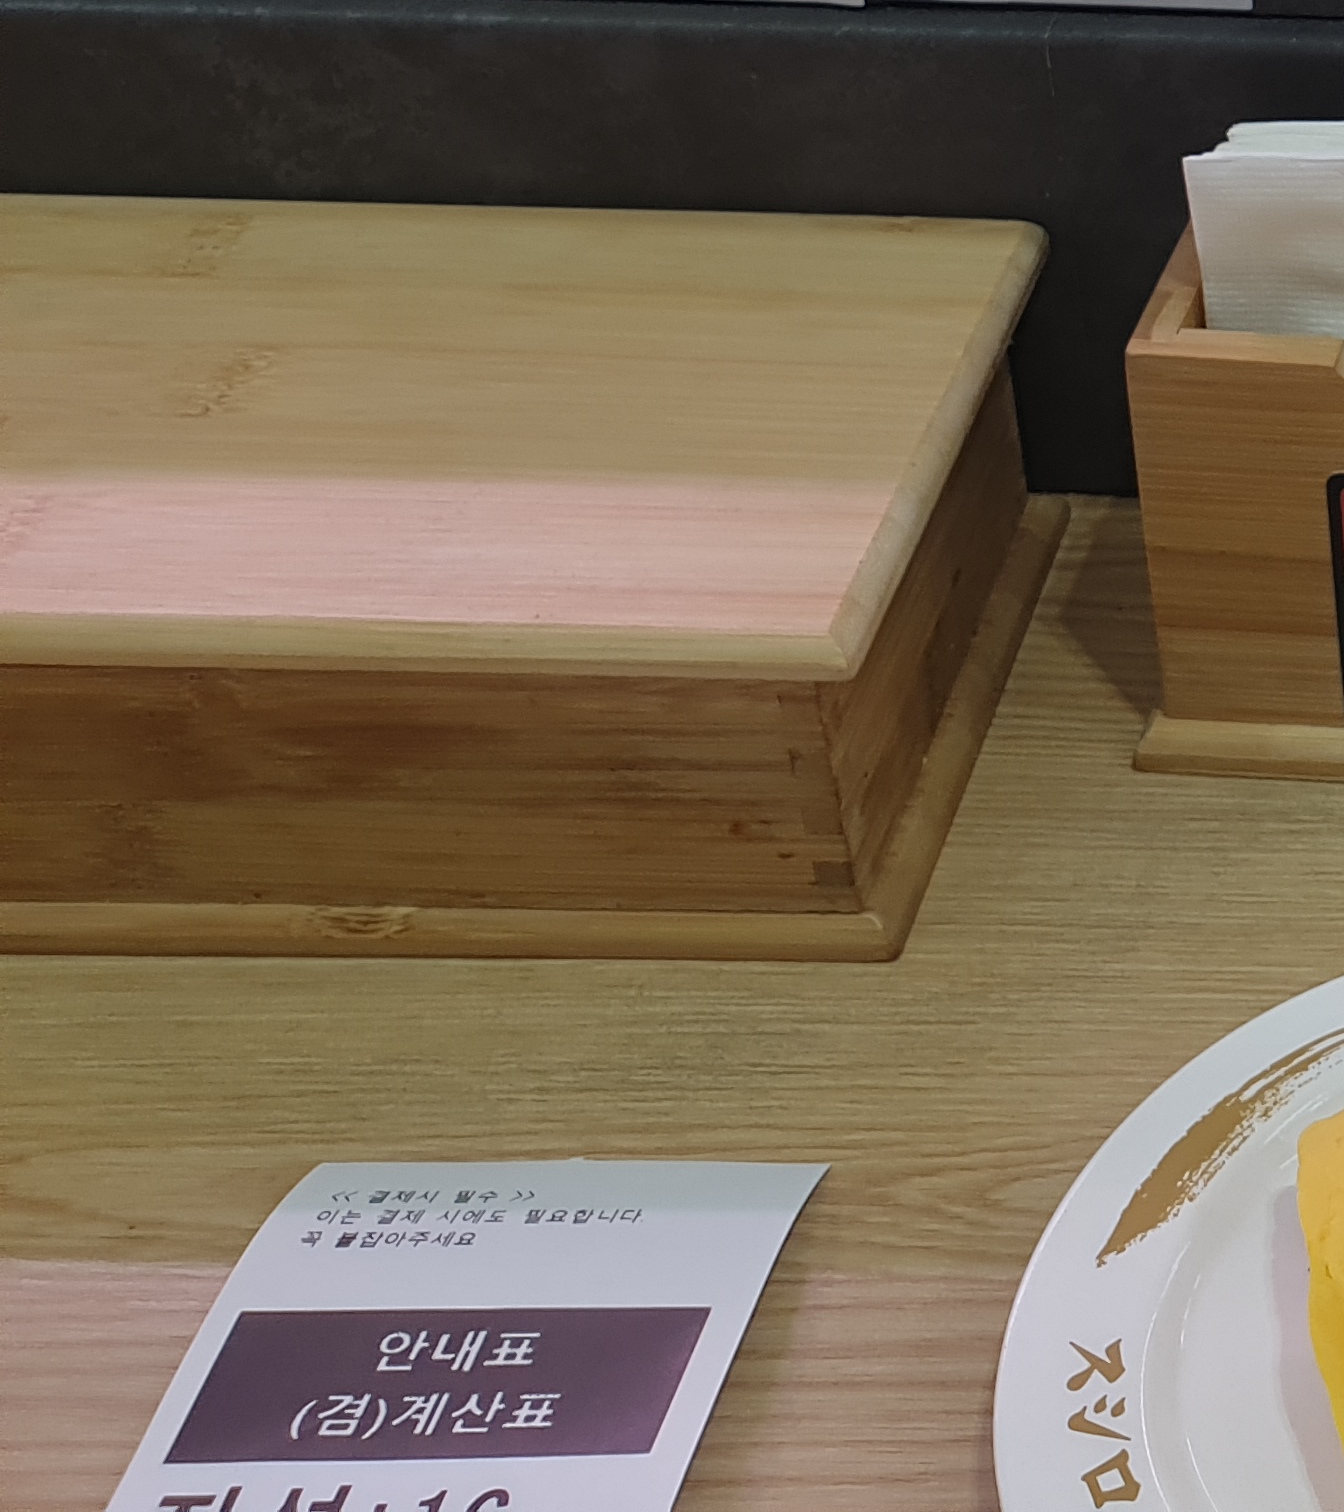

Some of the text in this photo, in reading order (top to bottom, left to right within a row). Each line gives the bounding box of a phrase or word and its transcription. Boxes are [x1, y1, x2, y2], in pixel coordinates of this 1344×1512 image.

[369, 1190, 499, 1205] 결제시 필수
[316, 1207, 646, 1226] 이는 결제 시에도 필요합니다.
[301, 1231, 323, 1248] 꼭
[375, 1329, 543, 1374] 안내표
[288, 1391, 563, 1441] (겸)계산표
[1065, 1337, 1143, 1510] スシロ
